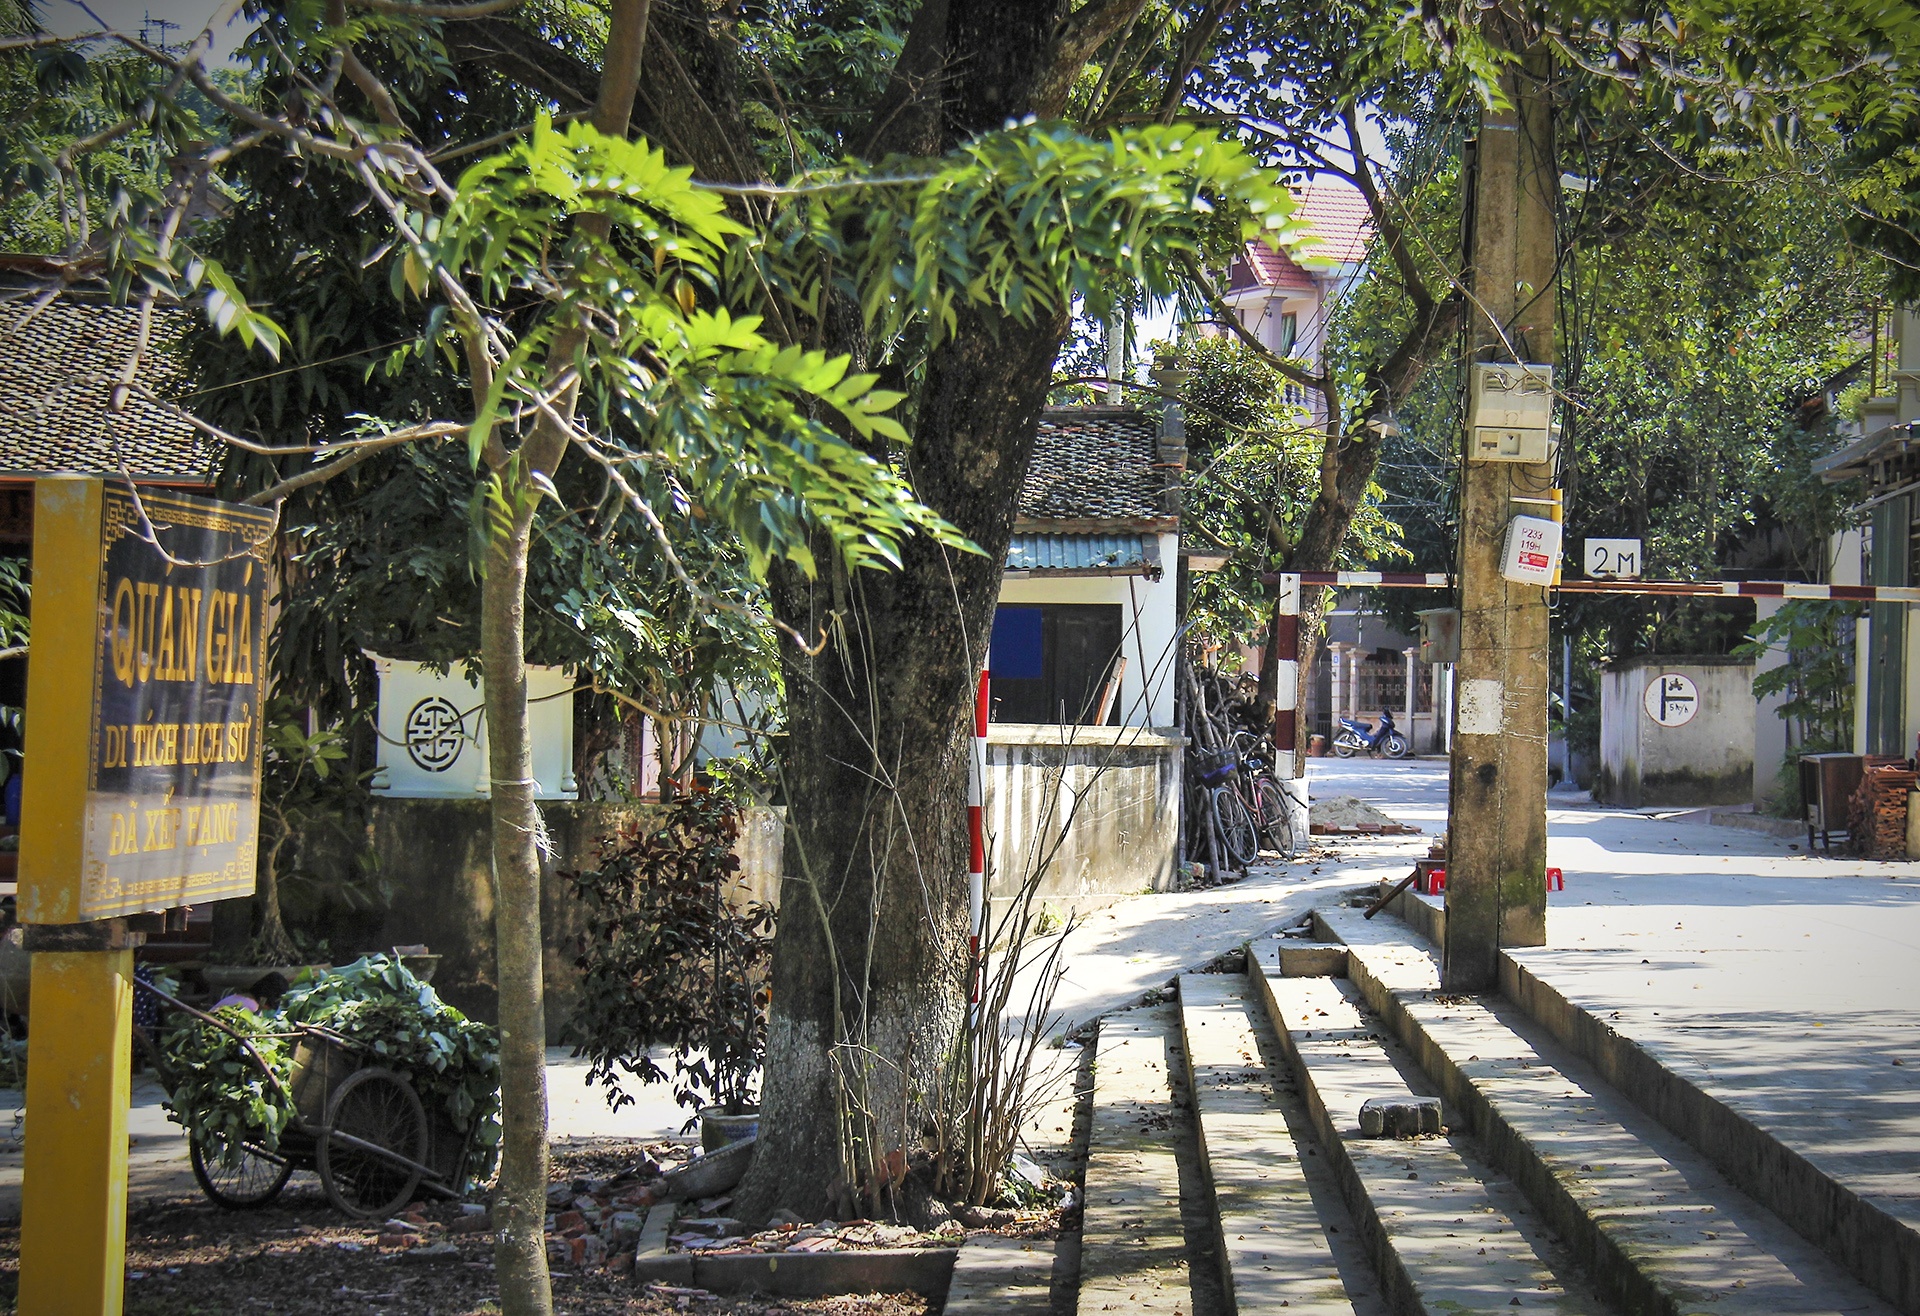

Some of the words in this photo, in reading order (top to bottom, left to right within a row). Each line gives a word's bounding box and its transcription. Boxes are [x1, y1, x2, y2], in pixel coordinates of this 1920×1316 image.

[112, 550, 202, 688] QUÁN
[206, 561, 254, 685] GIÁ
[104, 725, 129, 768] DI
[132, 709, 179, 767] TÍCH
[182, 722, 225, 777] LỊCH
[227, 702, 252, 762] SỬ
[109, 800, 139, 856] ĐÃ
[143, 786, 182, 852] XẾP
[186, 802, 238, 857] HẠNG
